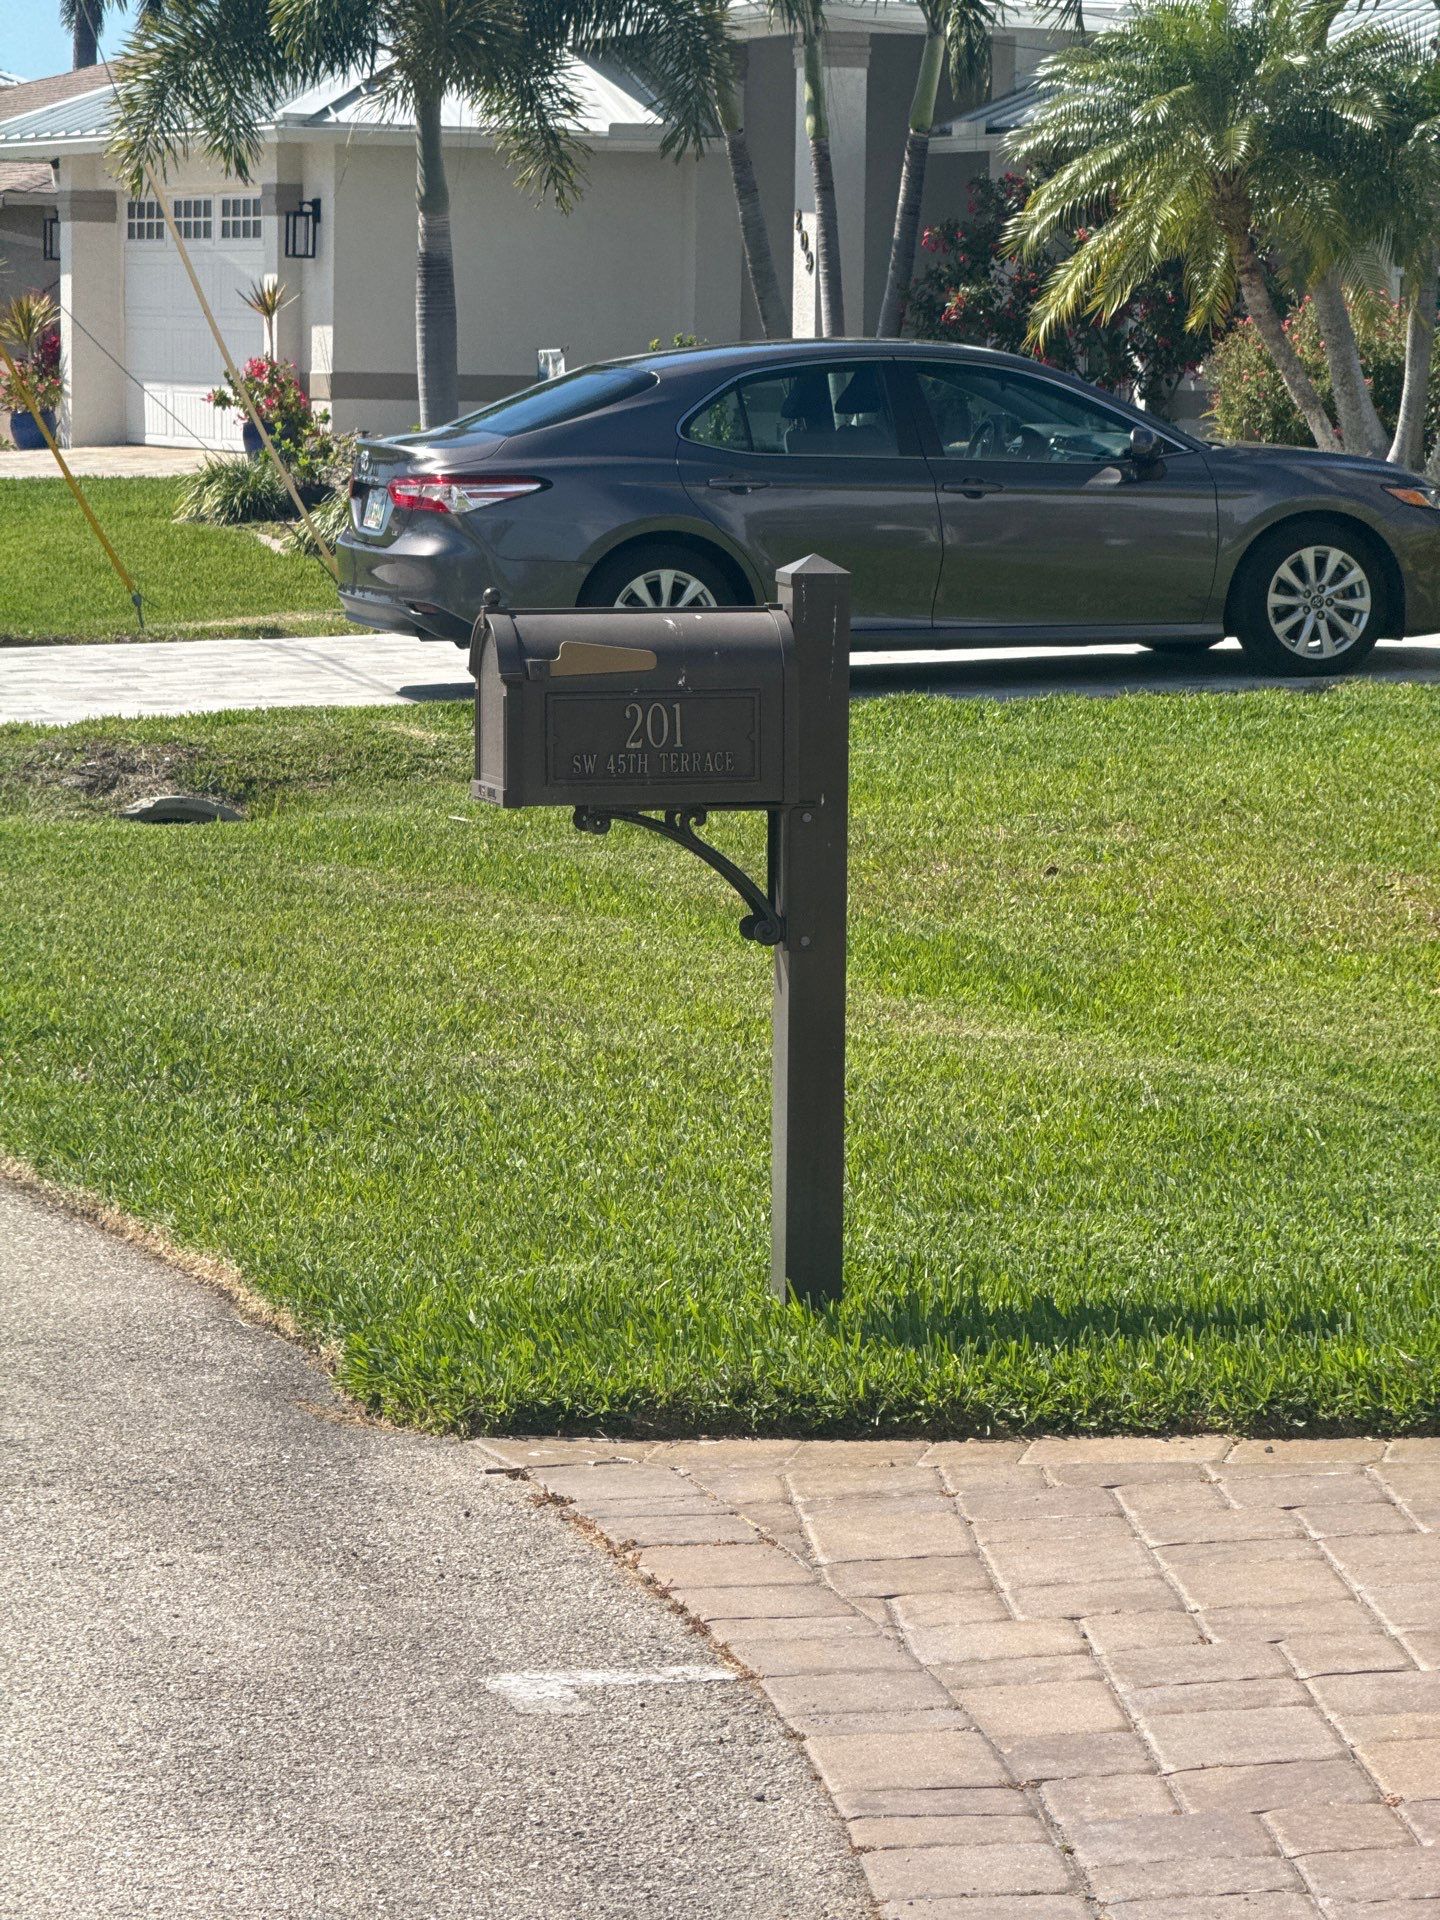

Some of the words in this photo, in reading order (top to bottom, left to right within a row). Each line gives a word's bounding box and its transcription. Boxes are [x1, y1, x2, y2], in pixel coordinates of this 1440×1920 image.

[624, 702, 683, 749] 201
[572, 754, 597, 774] SW
[606, 753, 649, 774] 45TH
[659, 751, 735, 773] TERRACE
